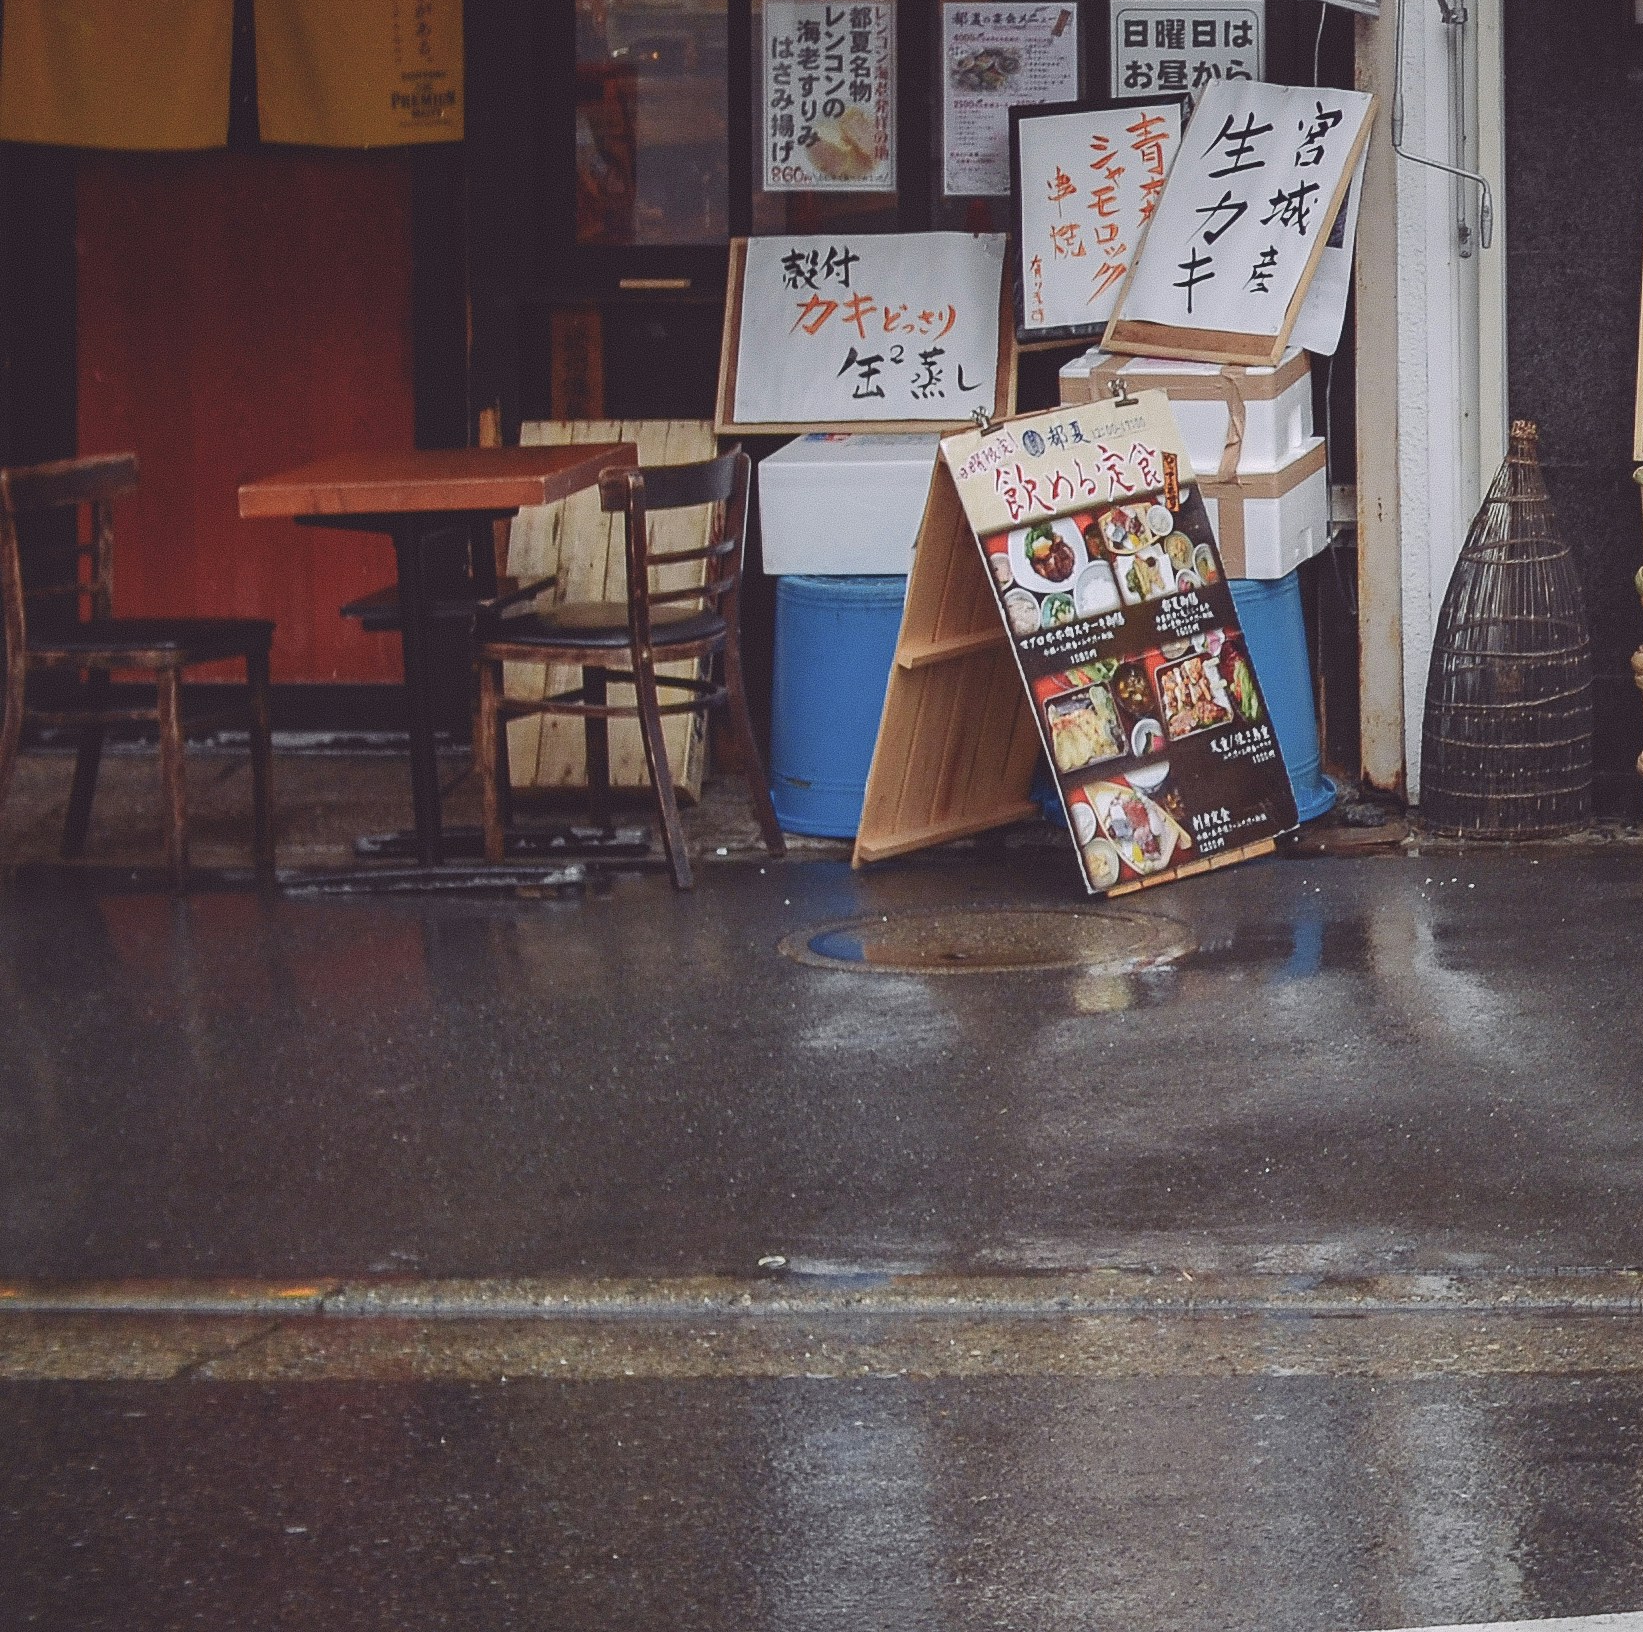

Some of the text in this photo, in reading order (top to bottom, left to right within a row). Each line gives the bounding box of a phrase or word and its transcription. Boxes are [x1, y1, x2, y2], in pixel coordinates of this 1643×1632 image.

[822, 5, 846, 118] レンコンの
[849, 5, 873, 103] 都夏名物
[1123, 18, 1253, 50] 日曜日は
[771, 36, 795, 164] はさみ揚げ
[797, 19, 822, 148] 海老すりみ
[1172, 111, 1275, 314] 生カキ
[781, 245, 860, 290] 殻付
[788, 292, 957, 342] カキどっさり
[1047, 420, 1091, 451] 都夏
[995, 442, 1162, 521] 飲める定食
